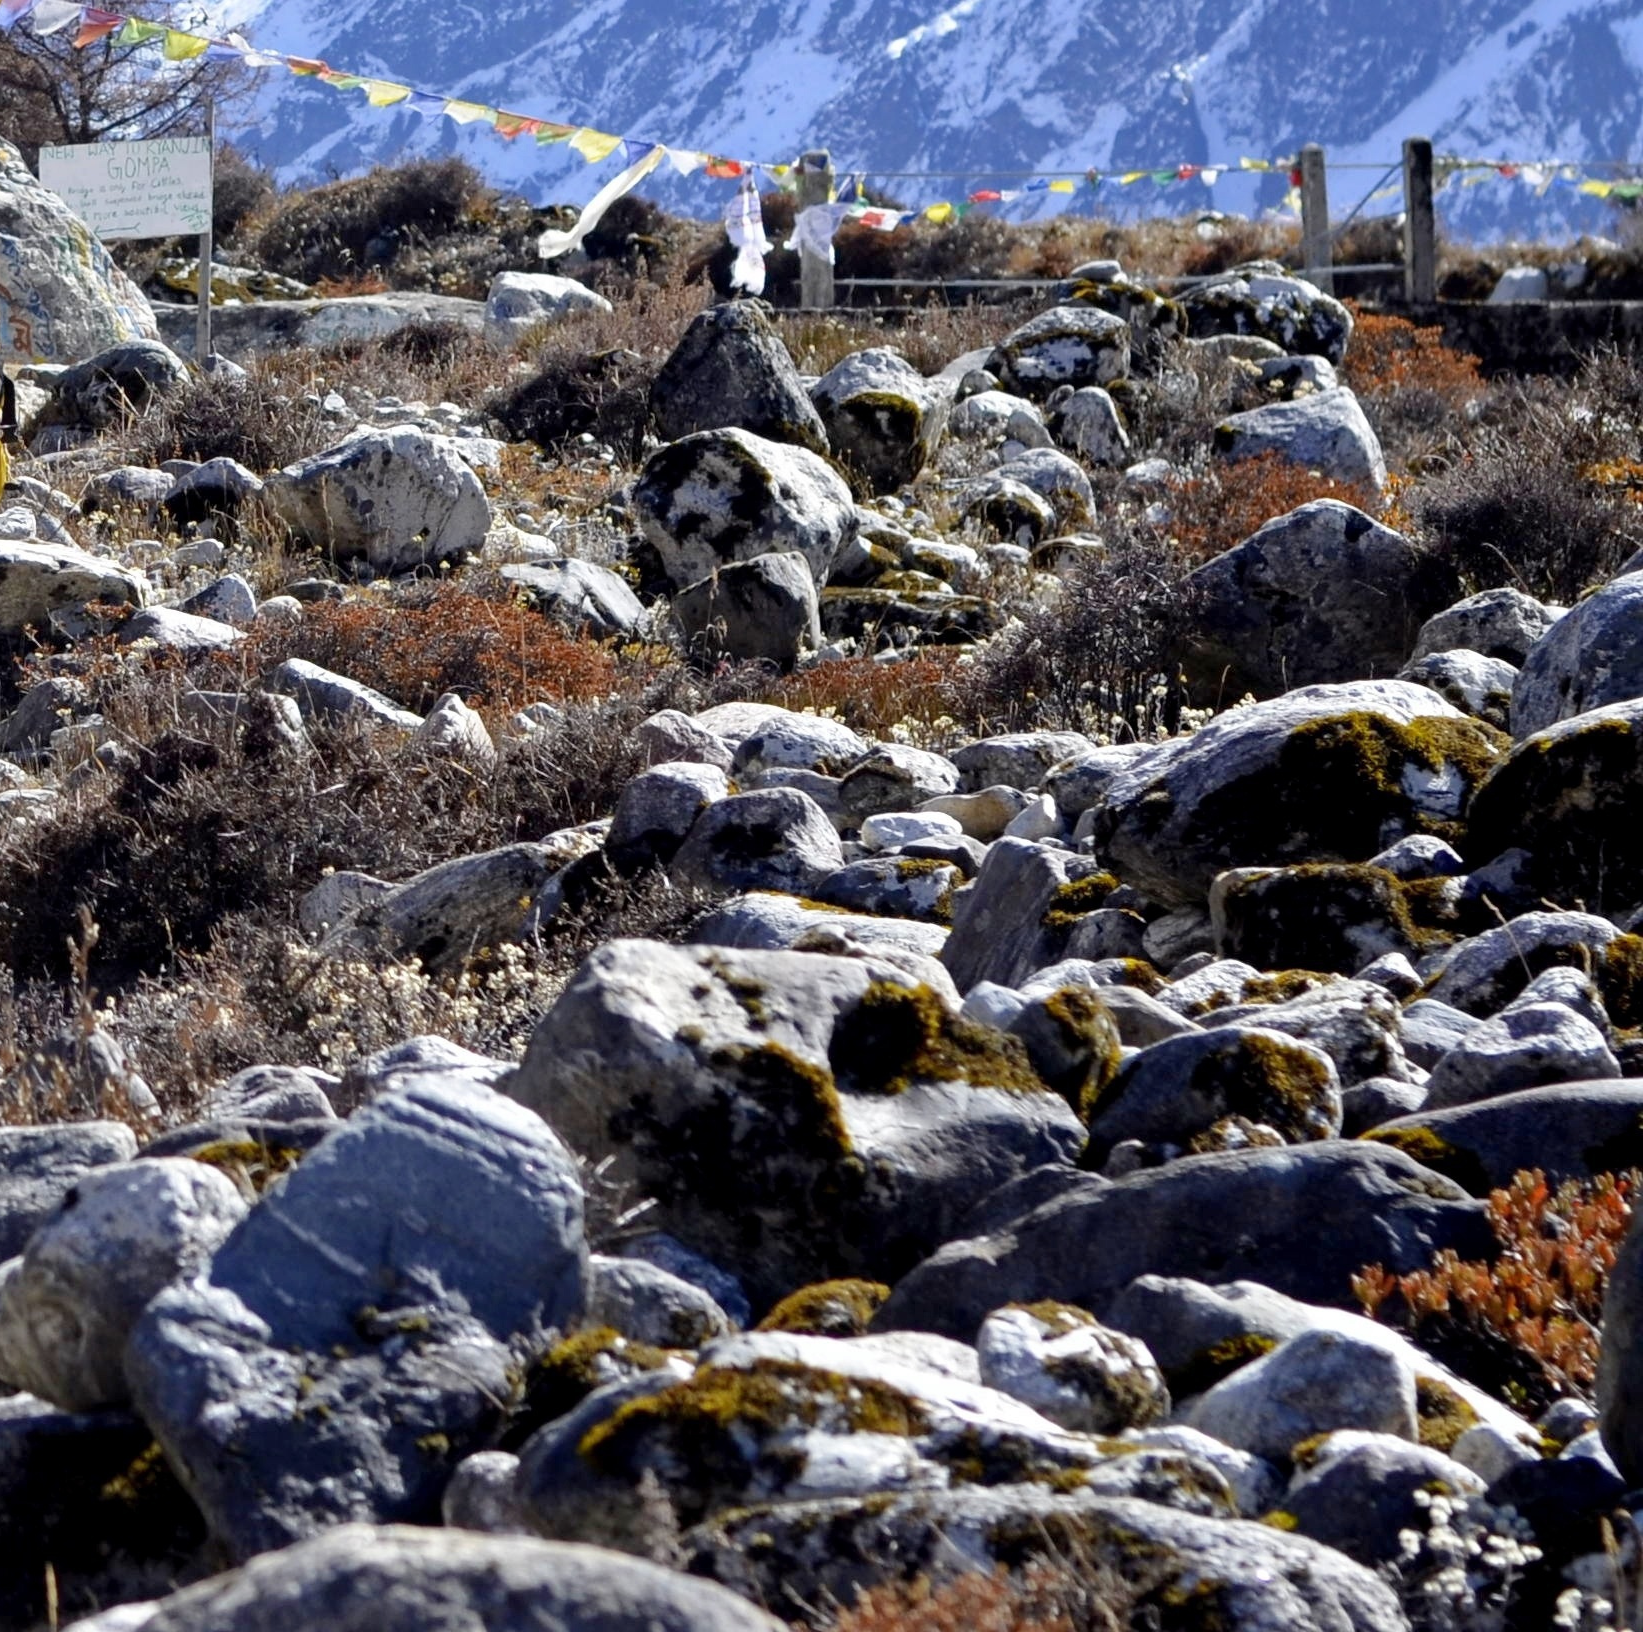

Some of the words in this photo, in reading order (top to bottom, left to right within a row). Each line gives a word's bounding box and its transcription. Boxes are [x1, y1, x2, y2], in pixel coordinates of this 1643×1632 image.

[43, 148, 74, 160] NEW
[88, 143, 116, 156] WAY
[125, 142, 140, 155] TO
[107, 156, 170, 179] GOMPA
